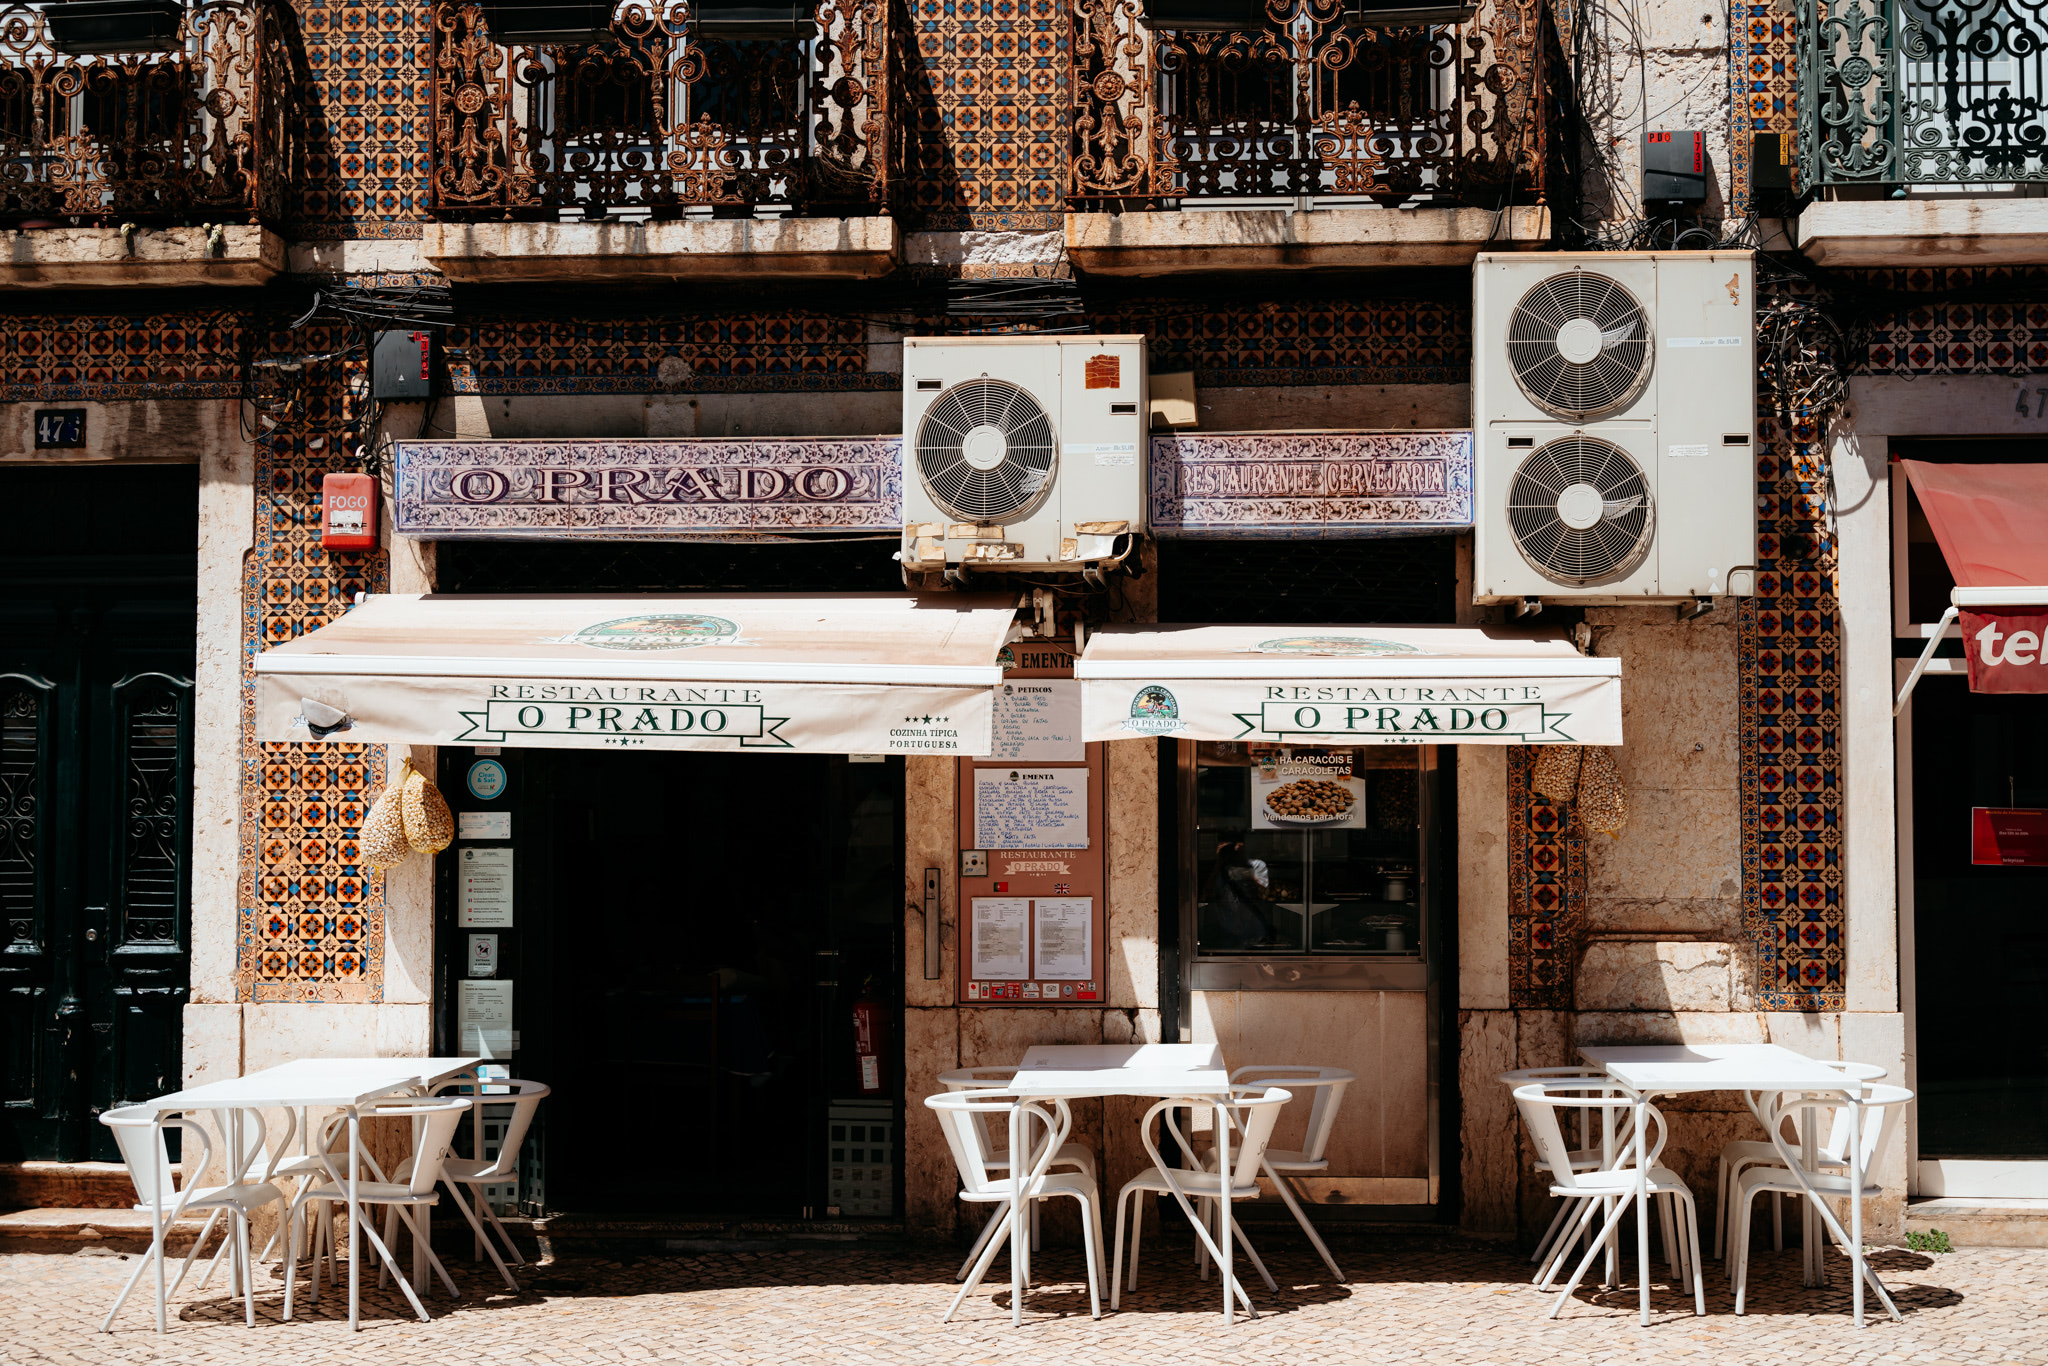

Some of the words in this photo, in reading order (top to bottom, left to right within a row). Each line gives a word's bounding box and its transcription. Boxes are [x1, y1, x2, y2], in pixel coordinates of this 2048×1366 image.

[1650, 133, 1671, 142] PDO
[1180, 463, 1314, 497] RESTAURANTE
[1327, 457, 1447, 497] CERVEJARIA
[449, 469, 511, 503] O
[535, 467, 855, 505] PRADO
[329, 495, 368, 509] FOGO
[1021, 653, 1075, 669] EMENTA
[488, 684, 762, 703] RESTAURANTE
[1018, 686, 1053, 694] PETISCOS
[1264, 686, 1542, 702] RESTAURANTE
[517, 705, 547, 730] O
[565, 706, 730, 734] PRADO
[1141, 720, 1177, 728] PRADO
[1294, 706, 1322, 730] O
[1343, 706, 1510, 732] PRADO
[889, 729, 928, 737] COZINHA
[929, 727, 959, 738] TÍPICA
[889, 740, 959, 749] PORTUGUESA
[1279, 755, 1293, 764] HÁ
[1295, 754, 1345, 764] CARACÓIS
[1346, 755, 1353, 764] E
[1281, 766, 1352, 775] CARACOLETAS
[1263, 813, 1311, 821] Vendemos
[1313, 814, 1334, 822] para
[1335, 812, 1354, 821] fora
[1000, 851, 1077, 859] RESTAURANTE
